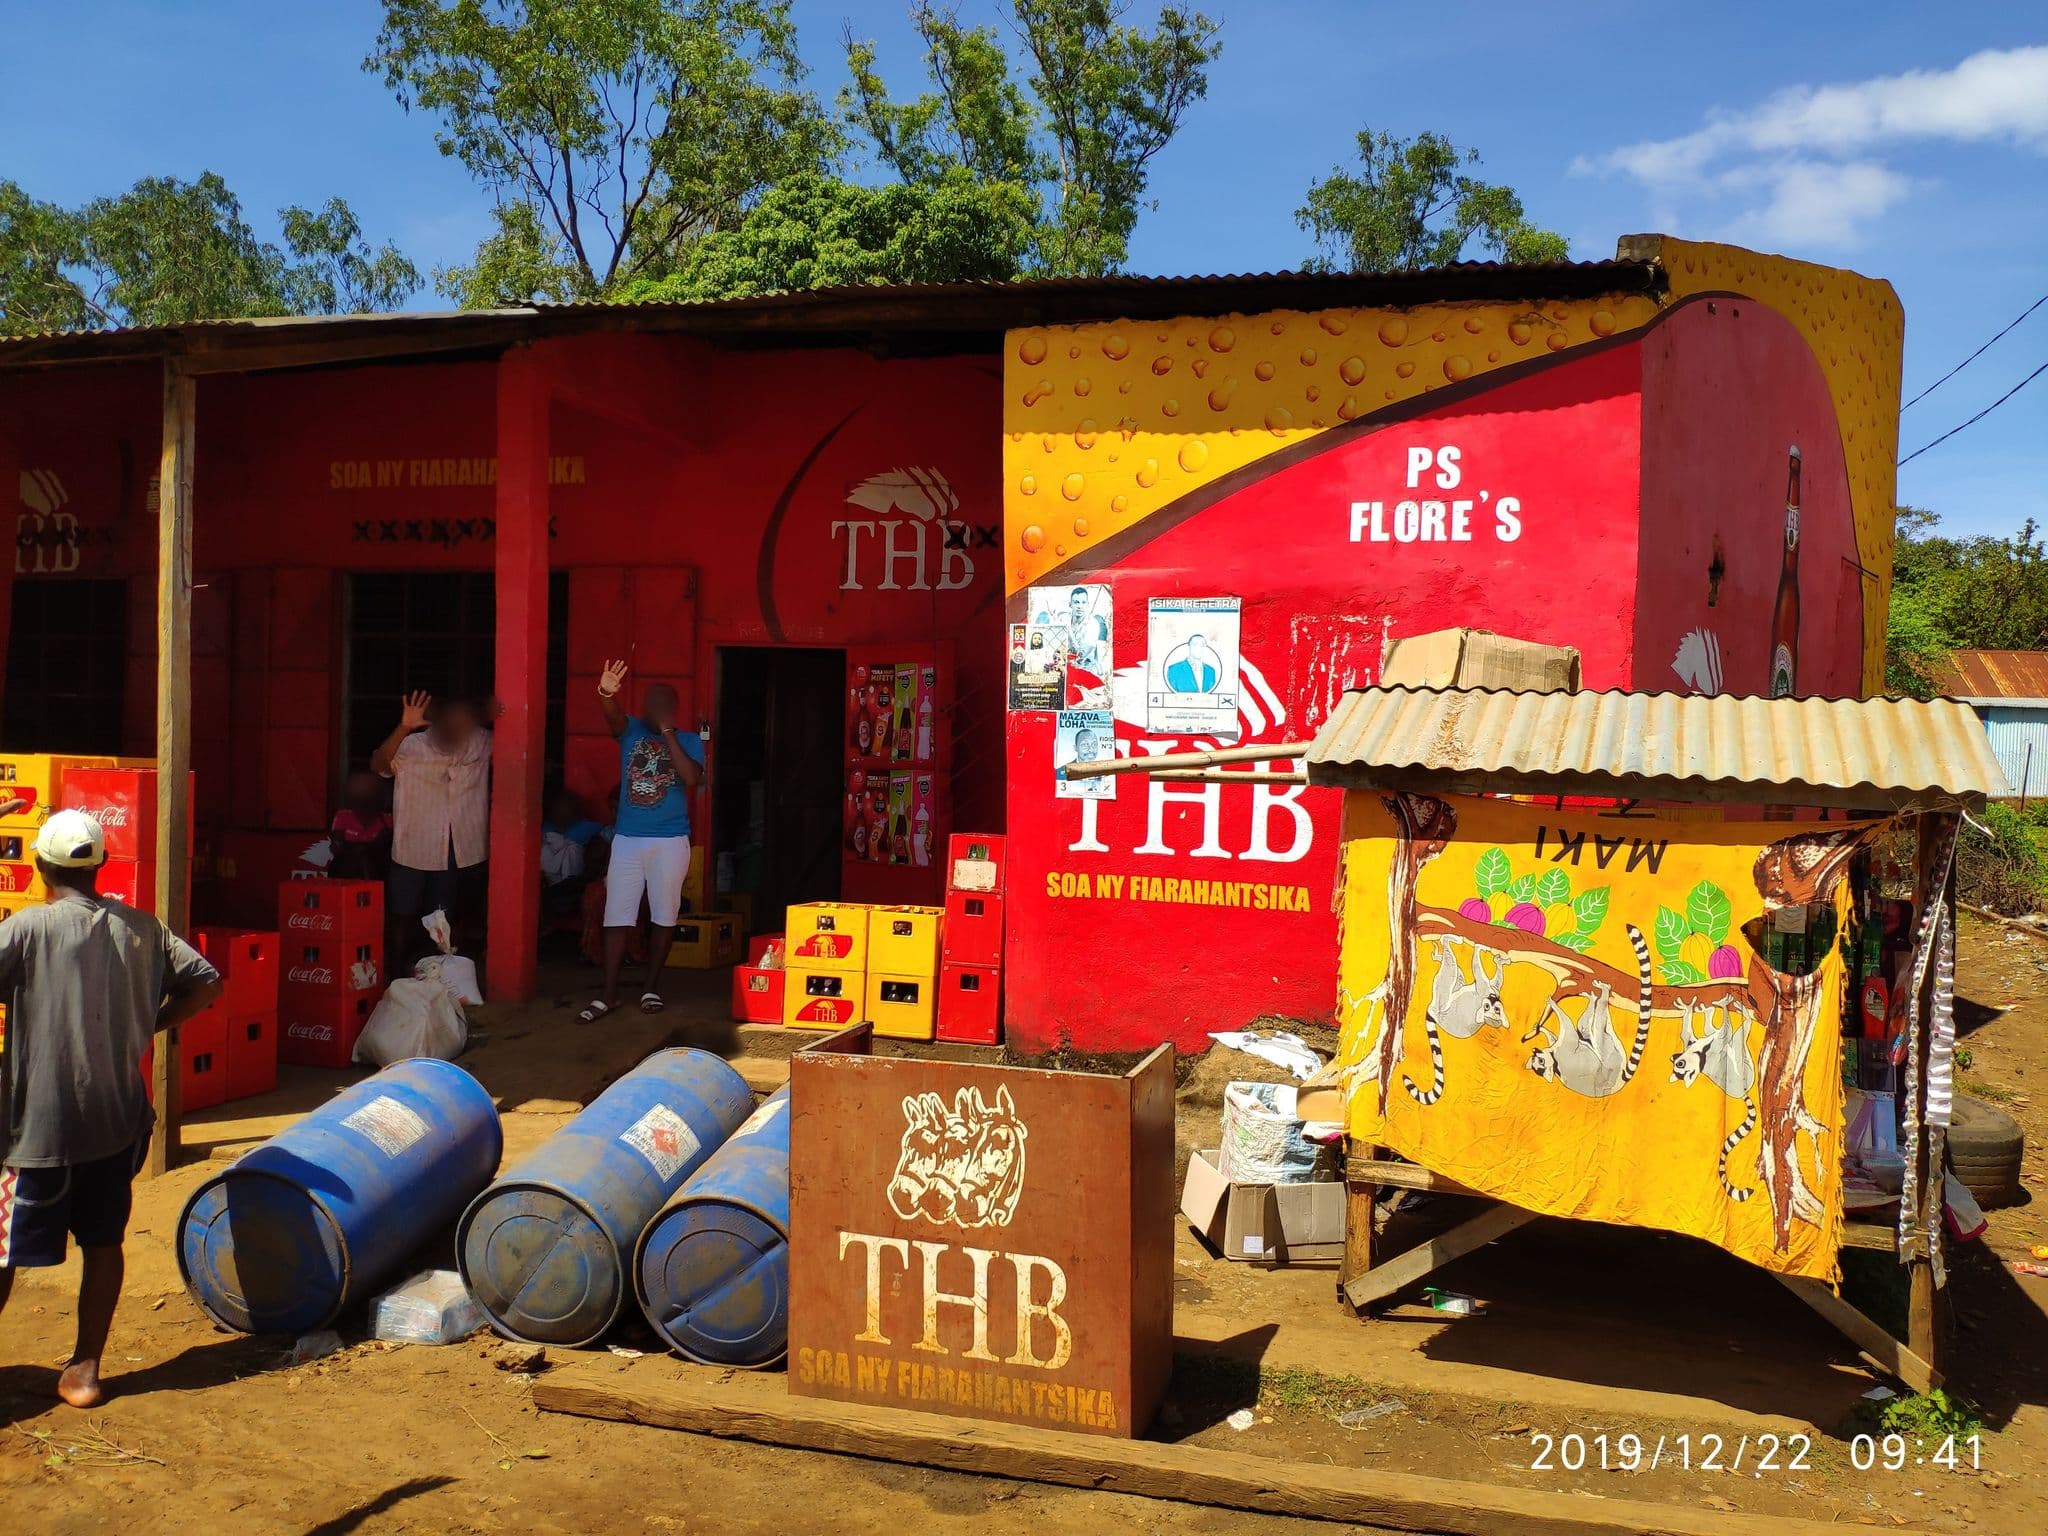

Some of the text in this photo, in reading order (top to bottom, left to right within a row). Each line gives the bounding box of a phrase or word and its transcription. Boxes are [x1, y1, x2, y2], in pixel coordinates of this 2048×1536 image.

[329, 459, 372, 489] SOA
[376, 457, 405, 487] NY
[1407, 446, 1462, 489] PS
[1349, 490, 1522, 542] FLORE'S
[831, 519, 976, 591] THB
[1059, 711, 1100, 721] MAZAVA
[1059, 720, 1085, 729] LOHA
[1053, 738, 1314, 863] THB
[1060, 782, 1067, 792] 3
[1534, 825, 1669, 875] MAKI
[1046, 872, 1312, 913] SOA NY FIARAHANTSIKA
[812, 943, 837, 957] THB
[813, 1007, 838, 1022] THB
[838, 1230, 1073, 1371] THB
[798, 1347, 1118, 1430] SOA NY FIARAHANTSIKA
